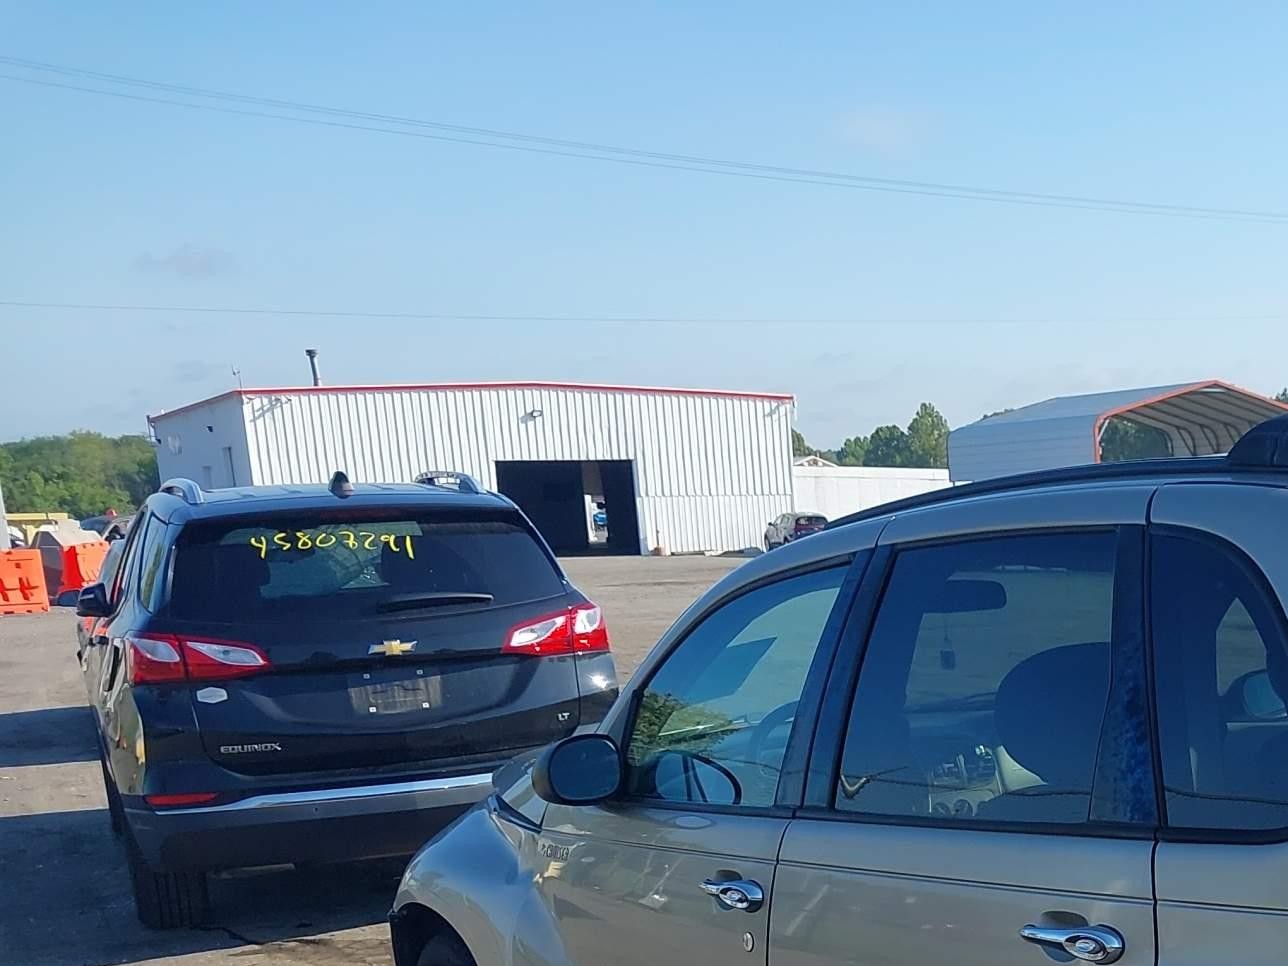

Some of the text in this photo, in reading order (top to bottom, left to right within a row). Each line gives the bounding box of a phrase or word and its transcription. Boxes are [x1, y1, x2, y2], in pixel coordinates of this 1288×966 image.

[250, 531, 414, 559] 45807291
[558, 712, 570, 721] LT
[220, 742, 282, 754] EQUINOX
